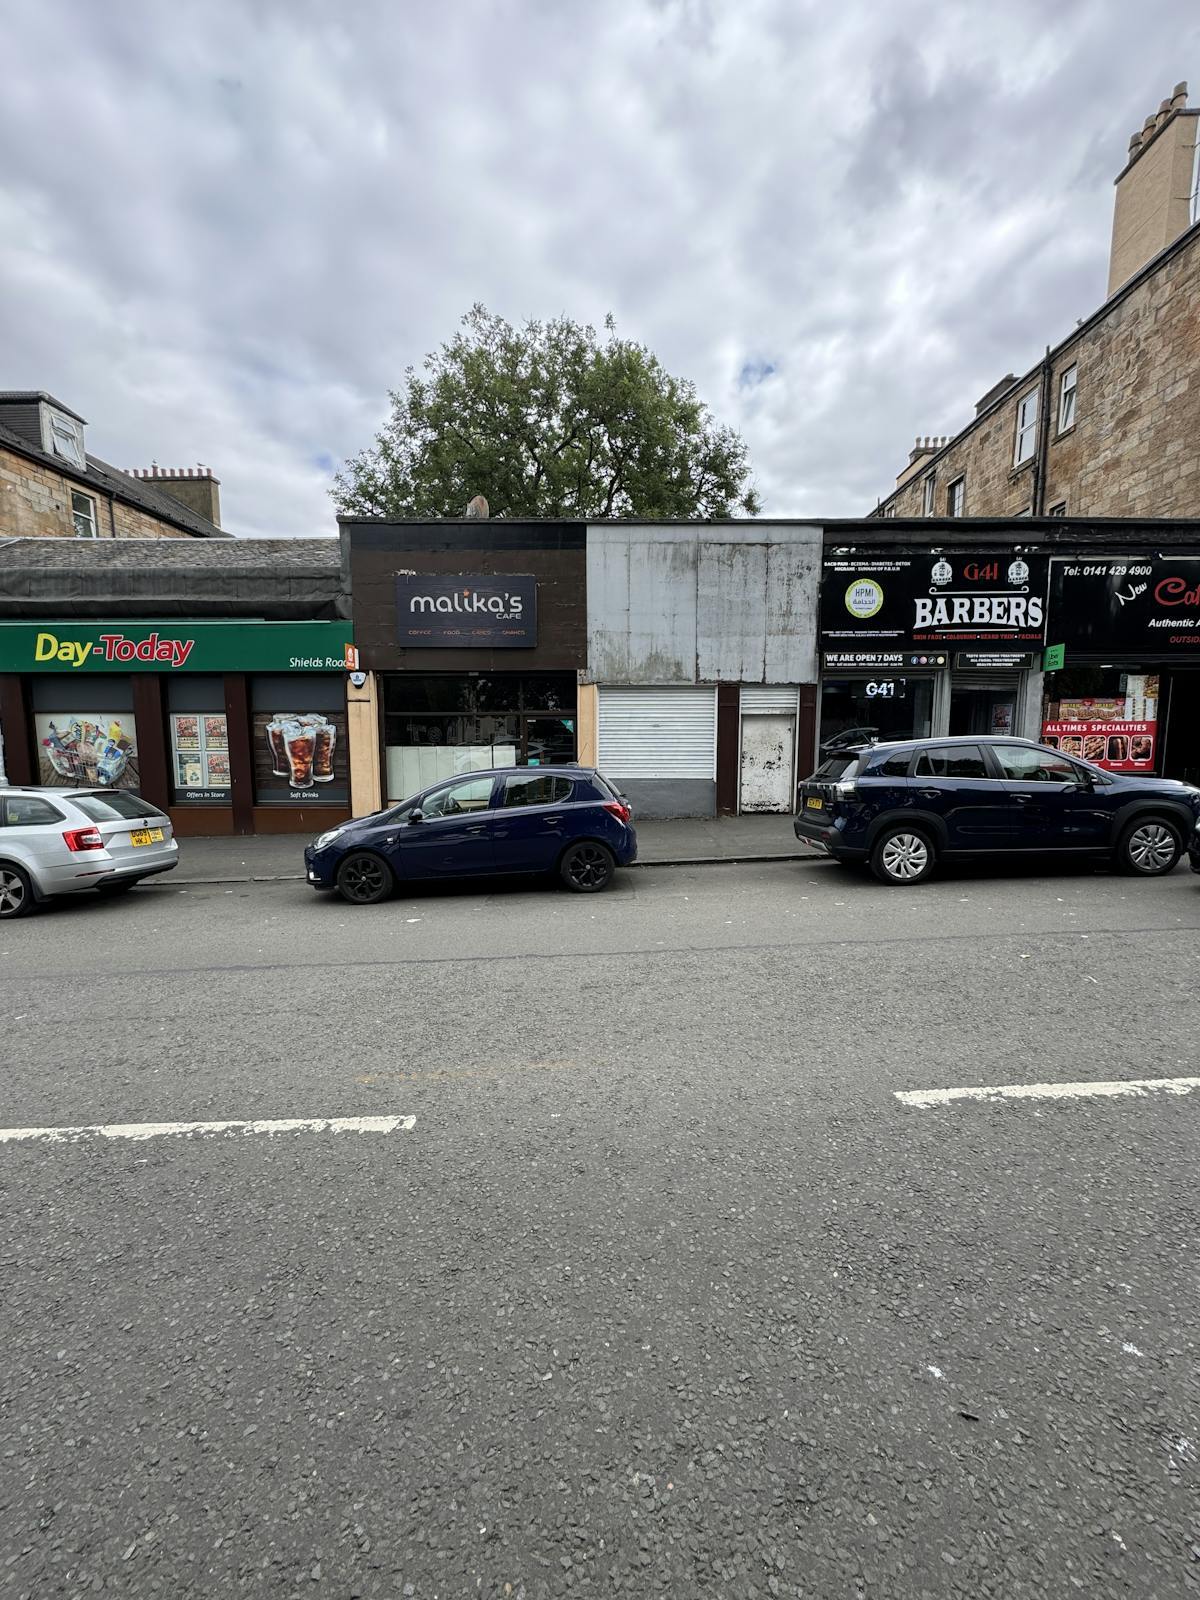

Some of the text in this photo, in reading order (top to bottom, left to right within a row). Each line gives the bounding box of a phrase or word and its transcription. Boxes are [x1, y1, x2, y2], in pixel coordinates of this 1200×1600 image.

[1063, 566, 1152, 576] Tel: 0141 429 4900
[855, 588, 874, 597] HPMI
[1114, 582, 1148, 606] New
[410, 589, 523, 613] malika's
[913, 597, 1043, 629] BARBERS
[1148, 619, 1194, 628] Authentic
[35, 633, 194, 667] Day-Today
[289, 657, 323, 668] Shields
[826, 654, 903, 662] WE ARE OPEN 7 DAYS
[866, 682, 895, 696] G41
[1091, 724, 1147, 732] SPECIALITIES
[186, 791, 203, 799] Offers
